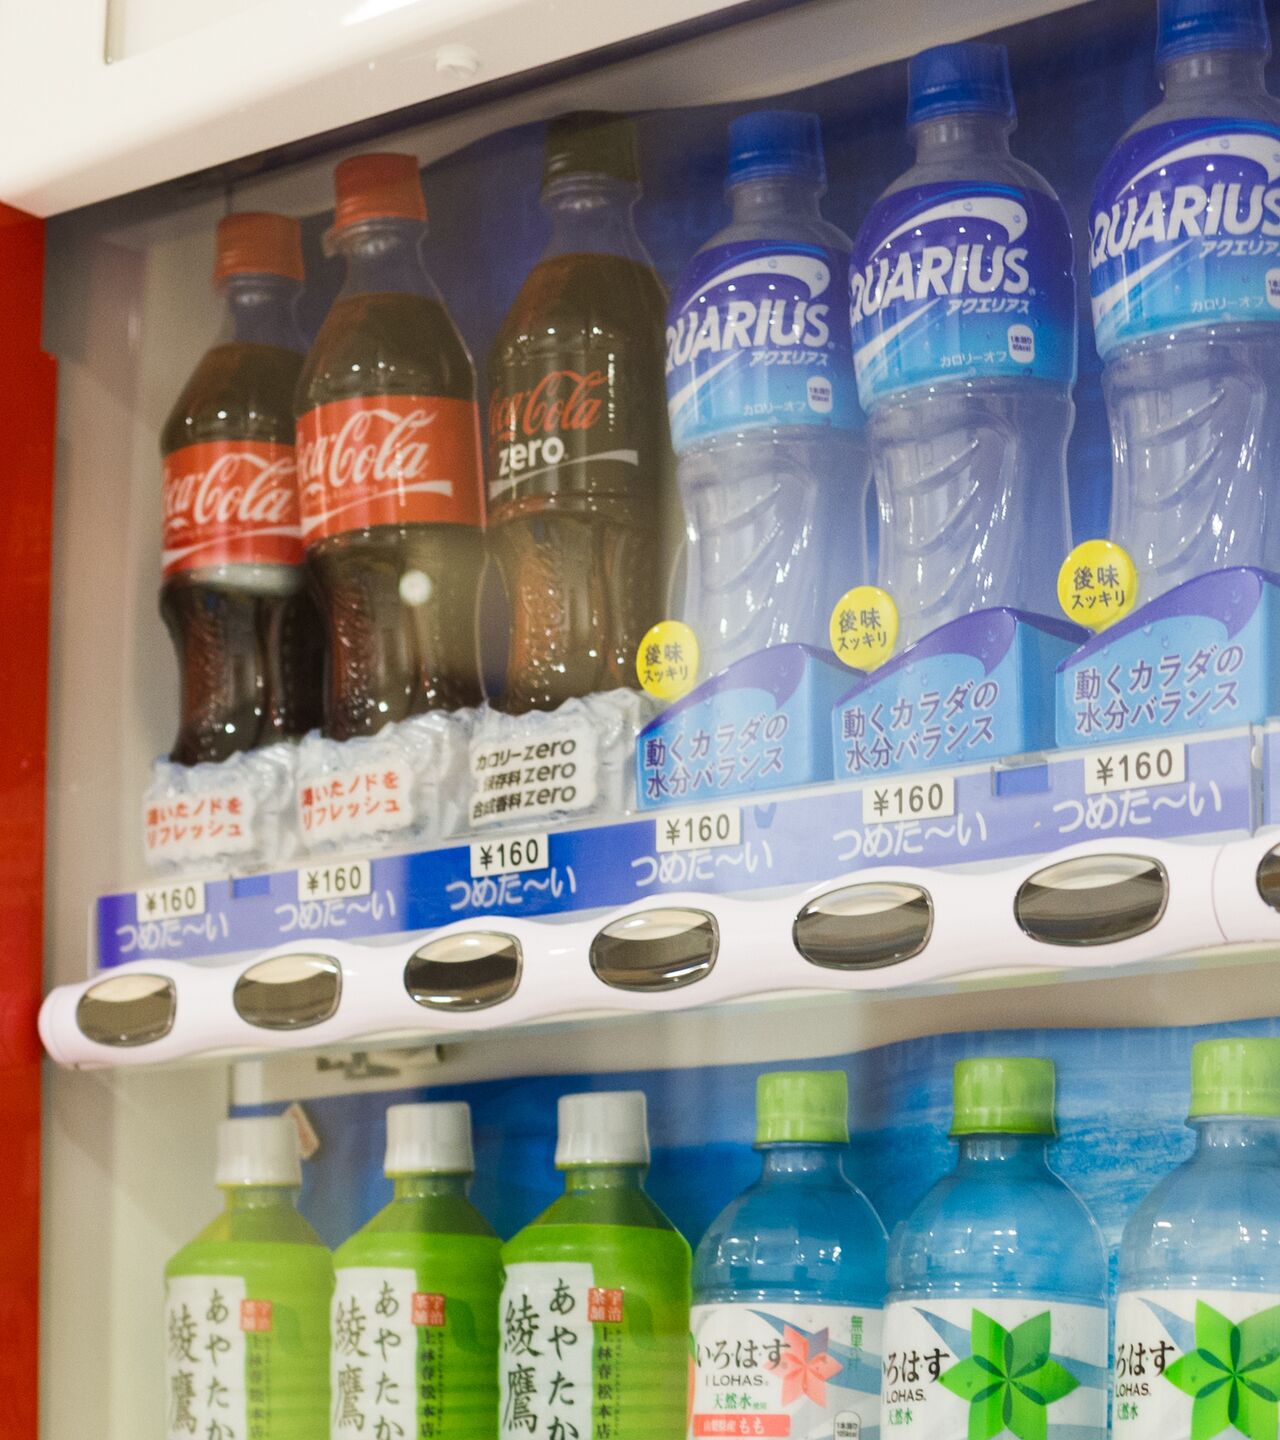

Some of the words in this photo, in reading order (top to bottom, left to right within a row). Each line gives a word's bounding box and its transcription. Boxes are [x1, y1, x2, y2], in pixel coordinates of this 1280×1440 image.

[947, 298, 1030, 317] アクエリアス
[1191, 295, 1265, 314] カロリーオフ
[498, 436, 565, 476] zero
[1073, 565, 1120, 591] 後味
[1071, 586, 1127, 611] スッキリ
[838, 606, 881, 634] 後味
[644, 641, 683, 665] 後味
[836, 629, 889, 654] スッキリ
[643, 662, 690, 684] スッキリ
[1075, 642, 1245, 702] 動くカラダの
[843, 677, 999, 740] 動くカラダの
[1075, 678, 1241, 734] 水分バランス
[644, 712, 790, 768] 動くカラダの
[845, 714, 994, 772] 水分バランス
[646, 746, 784, 799] 水分バランス
[1096, 748, 1175, 784] ¥160
[302, 795, 401, 833] リフレッシュ
[872, 787, 946, 816] ¥160
[665, 818, 732, 845] ¥160
[479, 838, 539, 870] ¥160
[306, 866, 362, 895] ¥160
[145, 886, 198, 913] ¥160
[502, 1293, 545, 1435] 綾鷹
[712, 1374, 764, 1387] LOHAS
